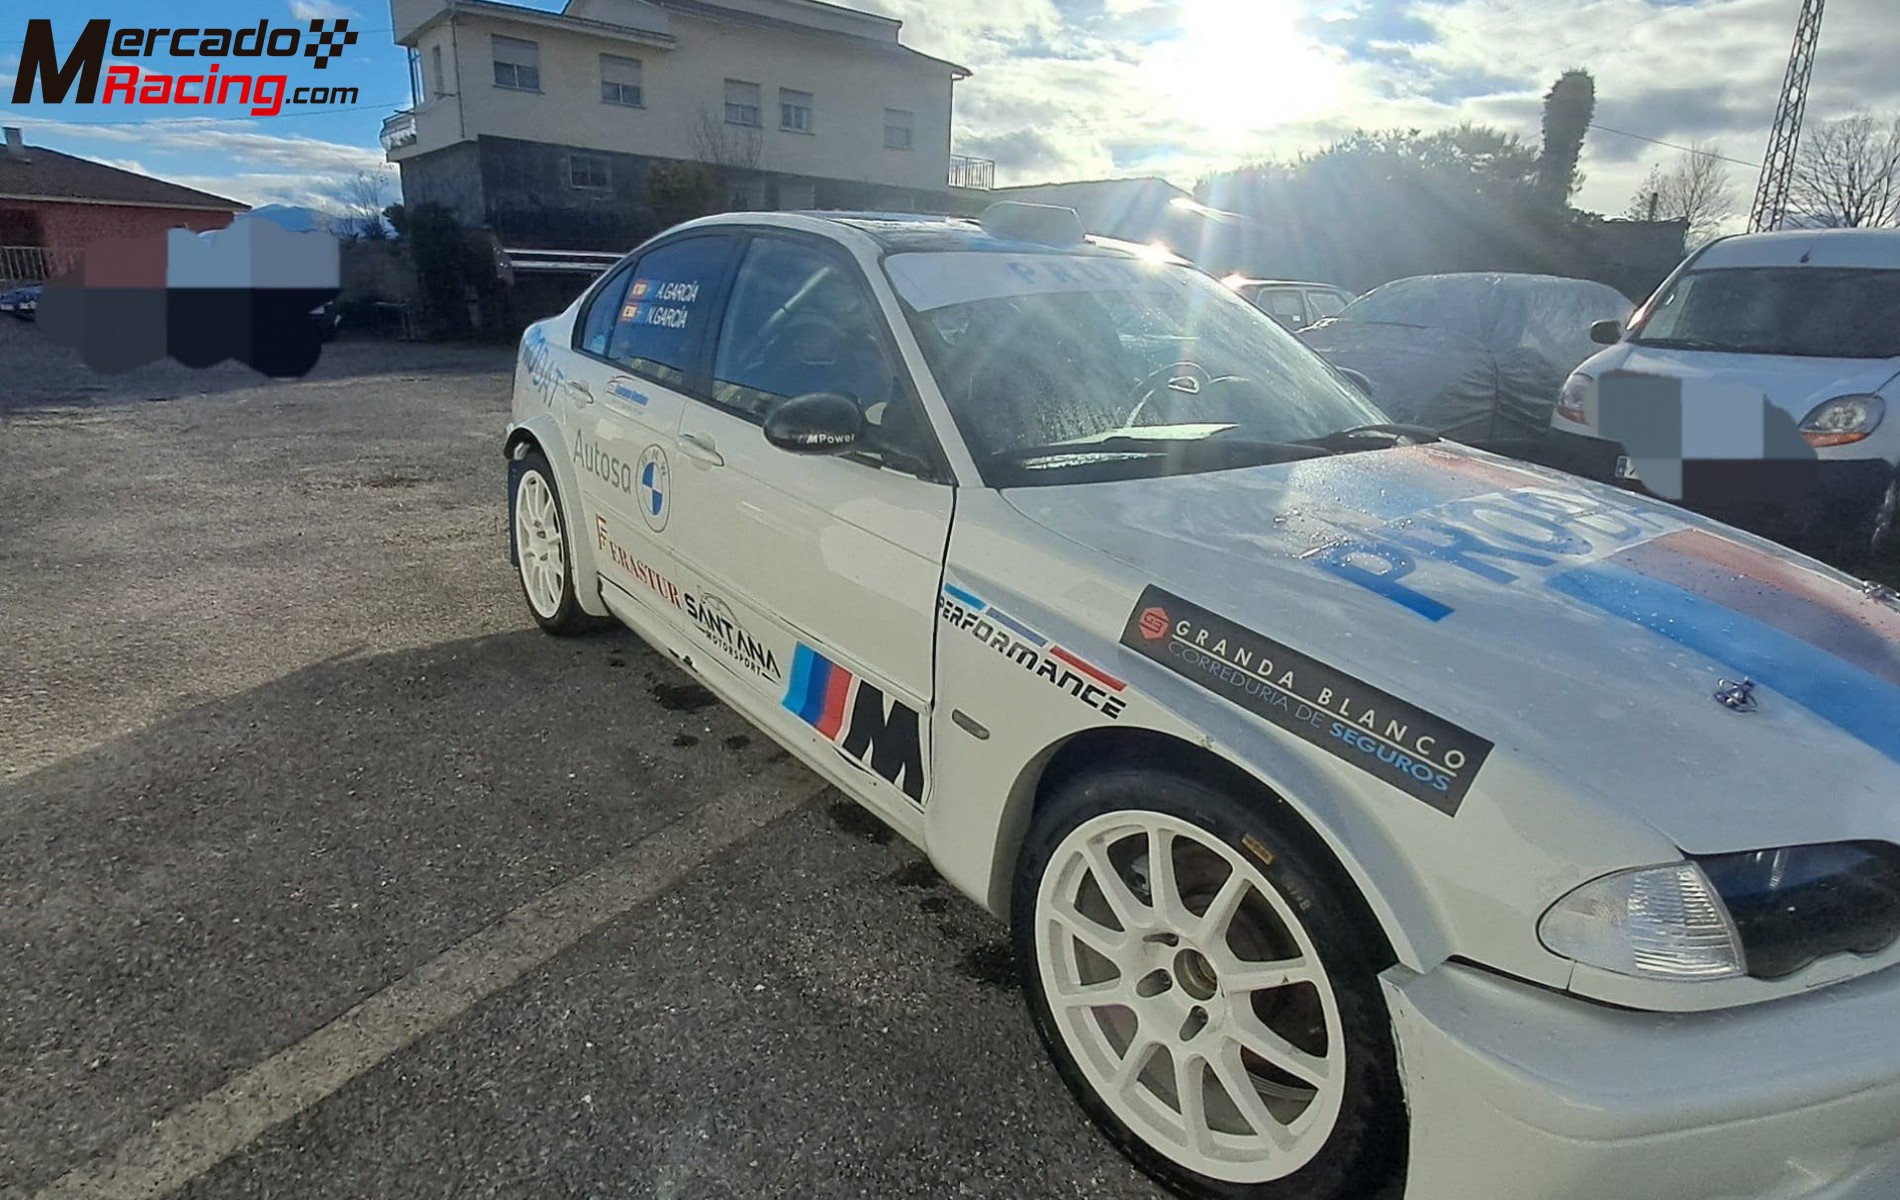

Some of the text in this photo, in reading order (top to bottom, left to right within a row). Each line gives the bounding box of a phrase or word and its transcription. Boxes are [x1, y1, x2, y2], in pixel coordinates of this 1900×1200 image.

[573, 428, 631, 495] Autosa
[684, 592, 781, 678] SANTANA
[705, 631, 761, 676] MOTORSPORT
[938, 596, 1127, 720] PERFORMANCE
[1175, 620, 1466, 770] GRANDA BLANCO
[842, 679, 925, 804] M
[1168, 641, 1451, 792] CORREDURIA DE SEGUROS
